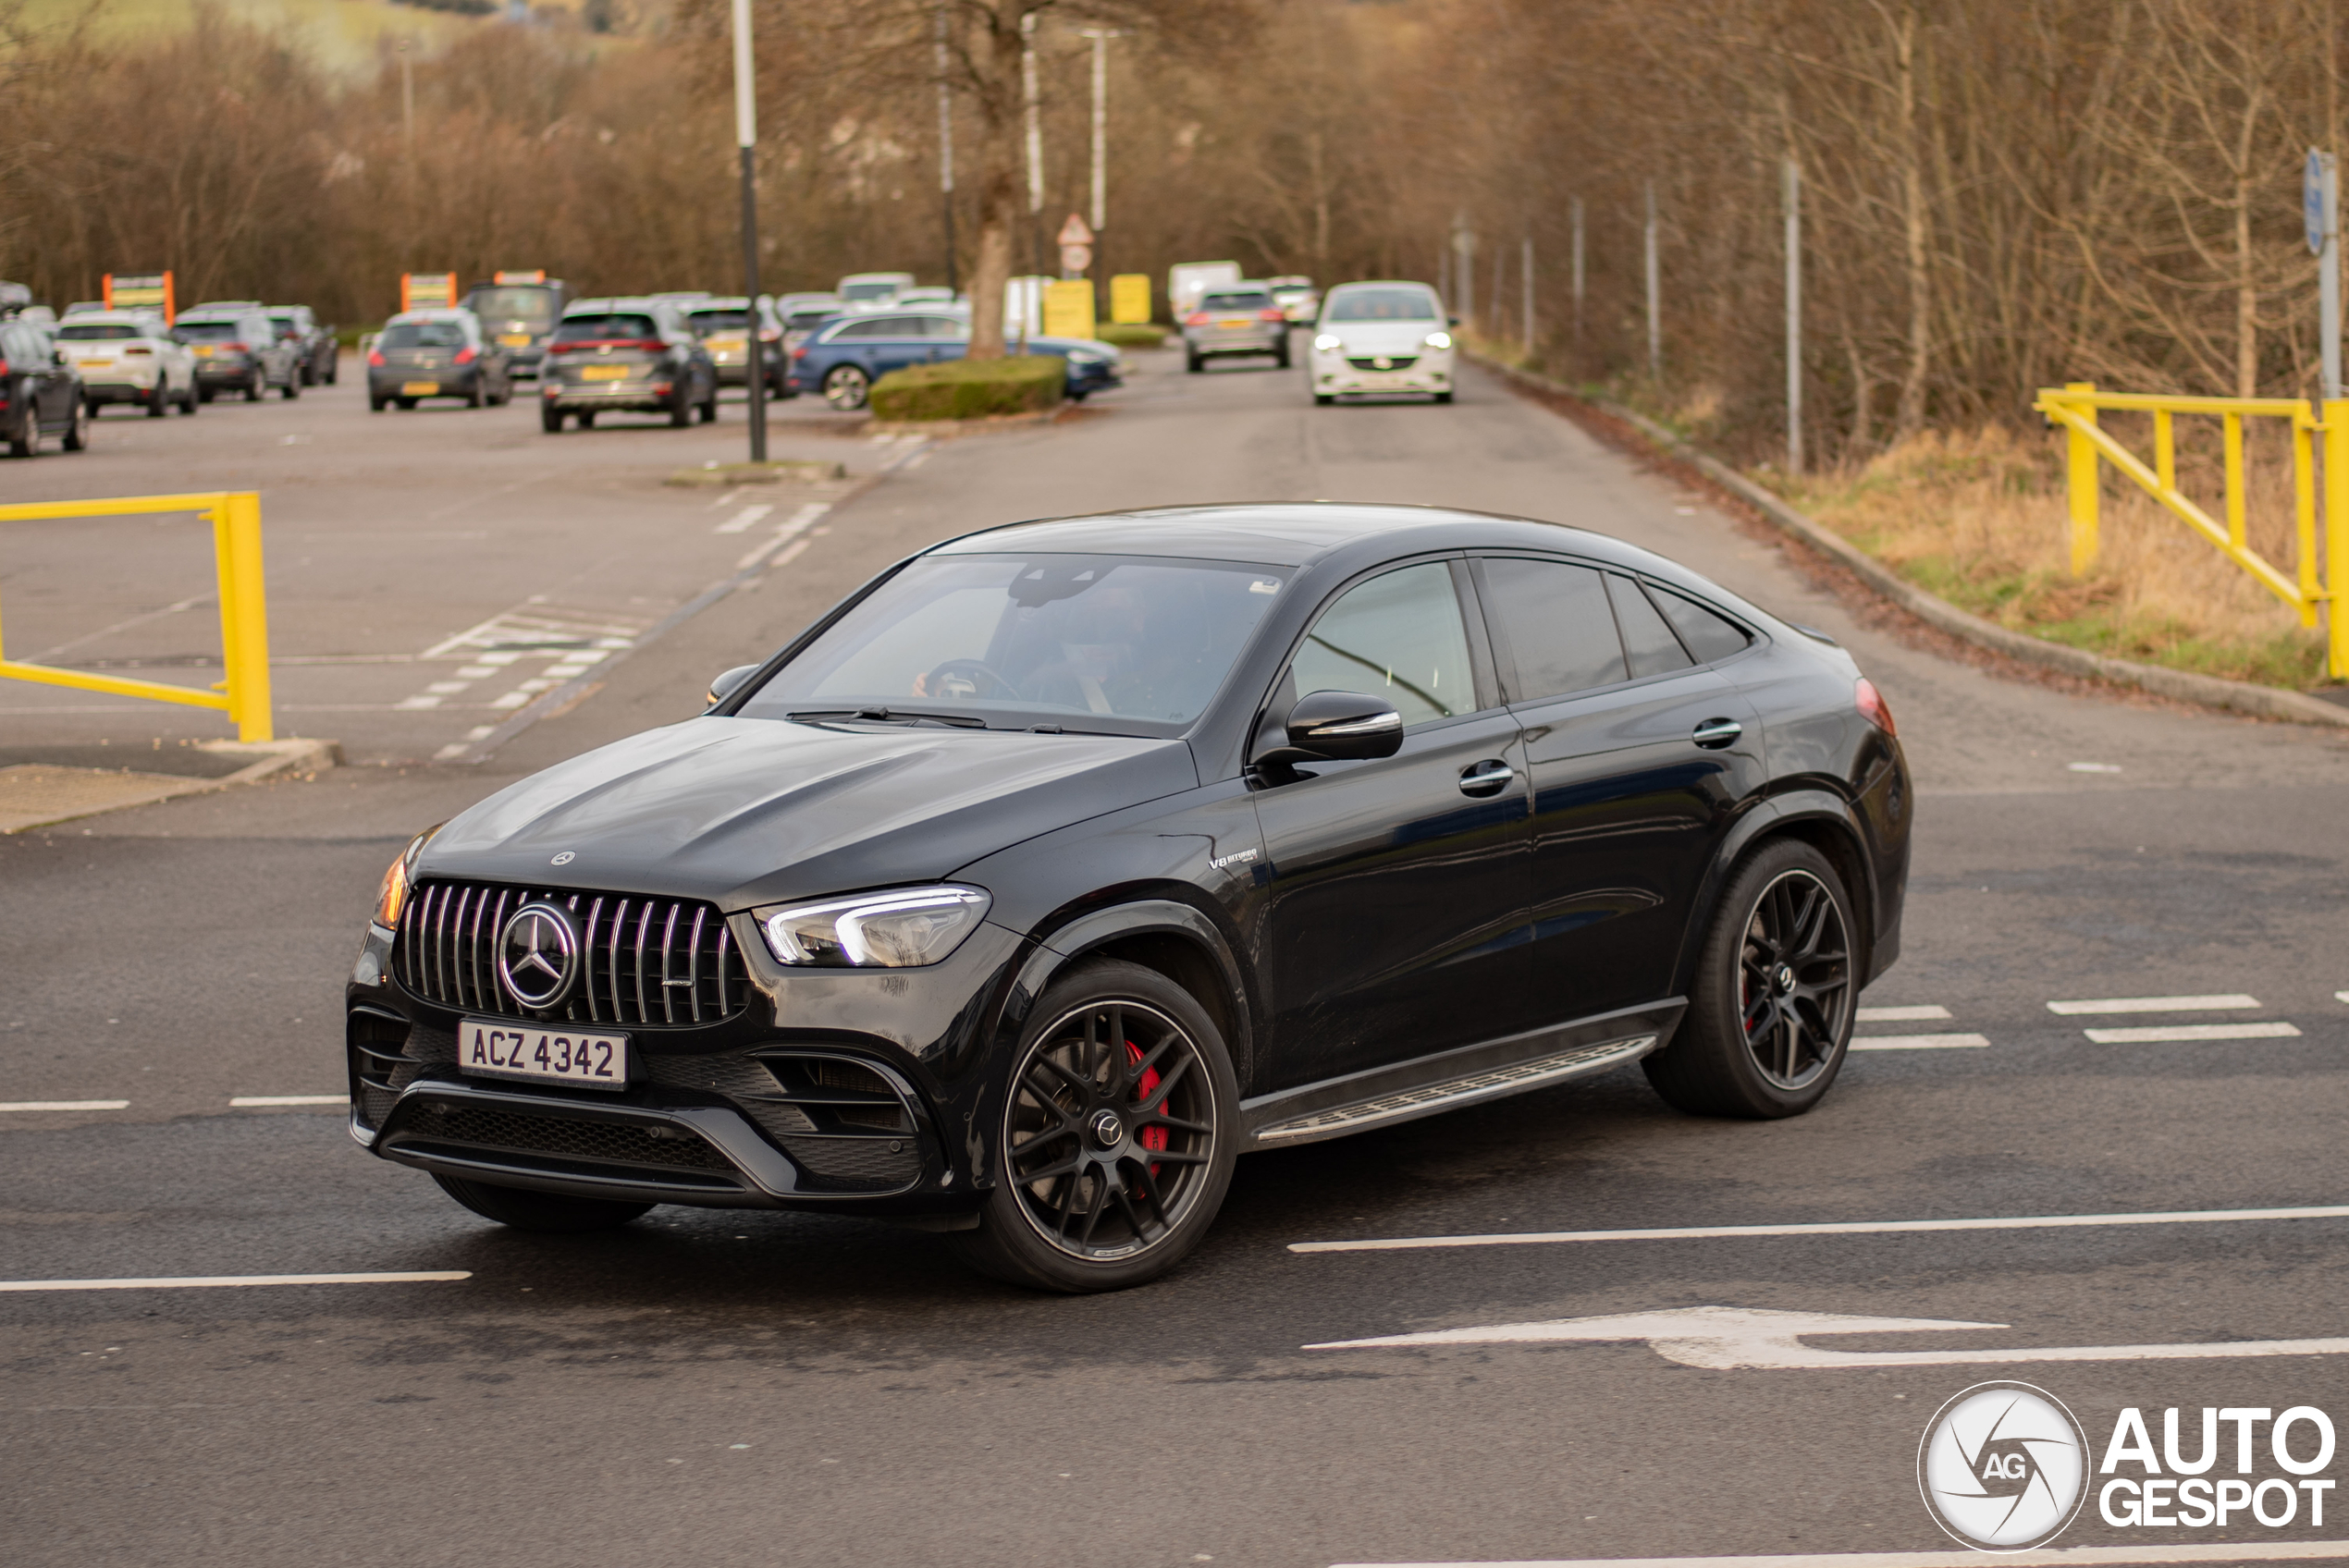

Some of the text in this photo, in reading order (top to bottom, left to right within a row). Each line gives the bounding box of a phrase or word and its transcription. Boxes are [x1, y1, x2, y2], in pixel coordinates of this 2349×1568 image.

[1209, 857, 1227, 869] V8
[473, 1028, 613, 1077] ACZ 4342
